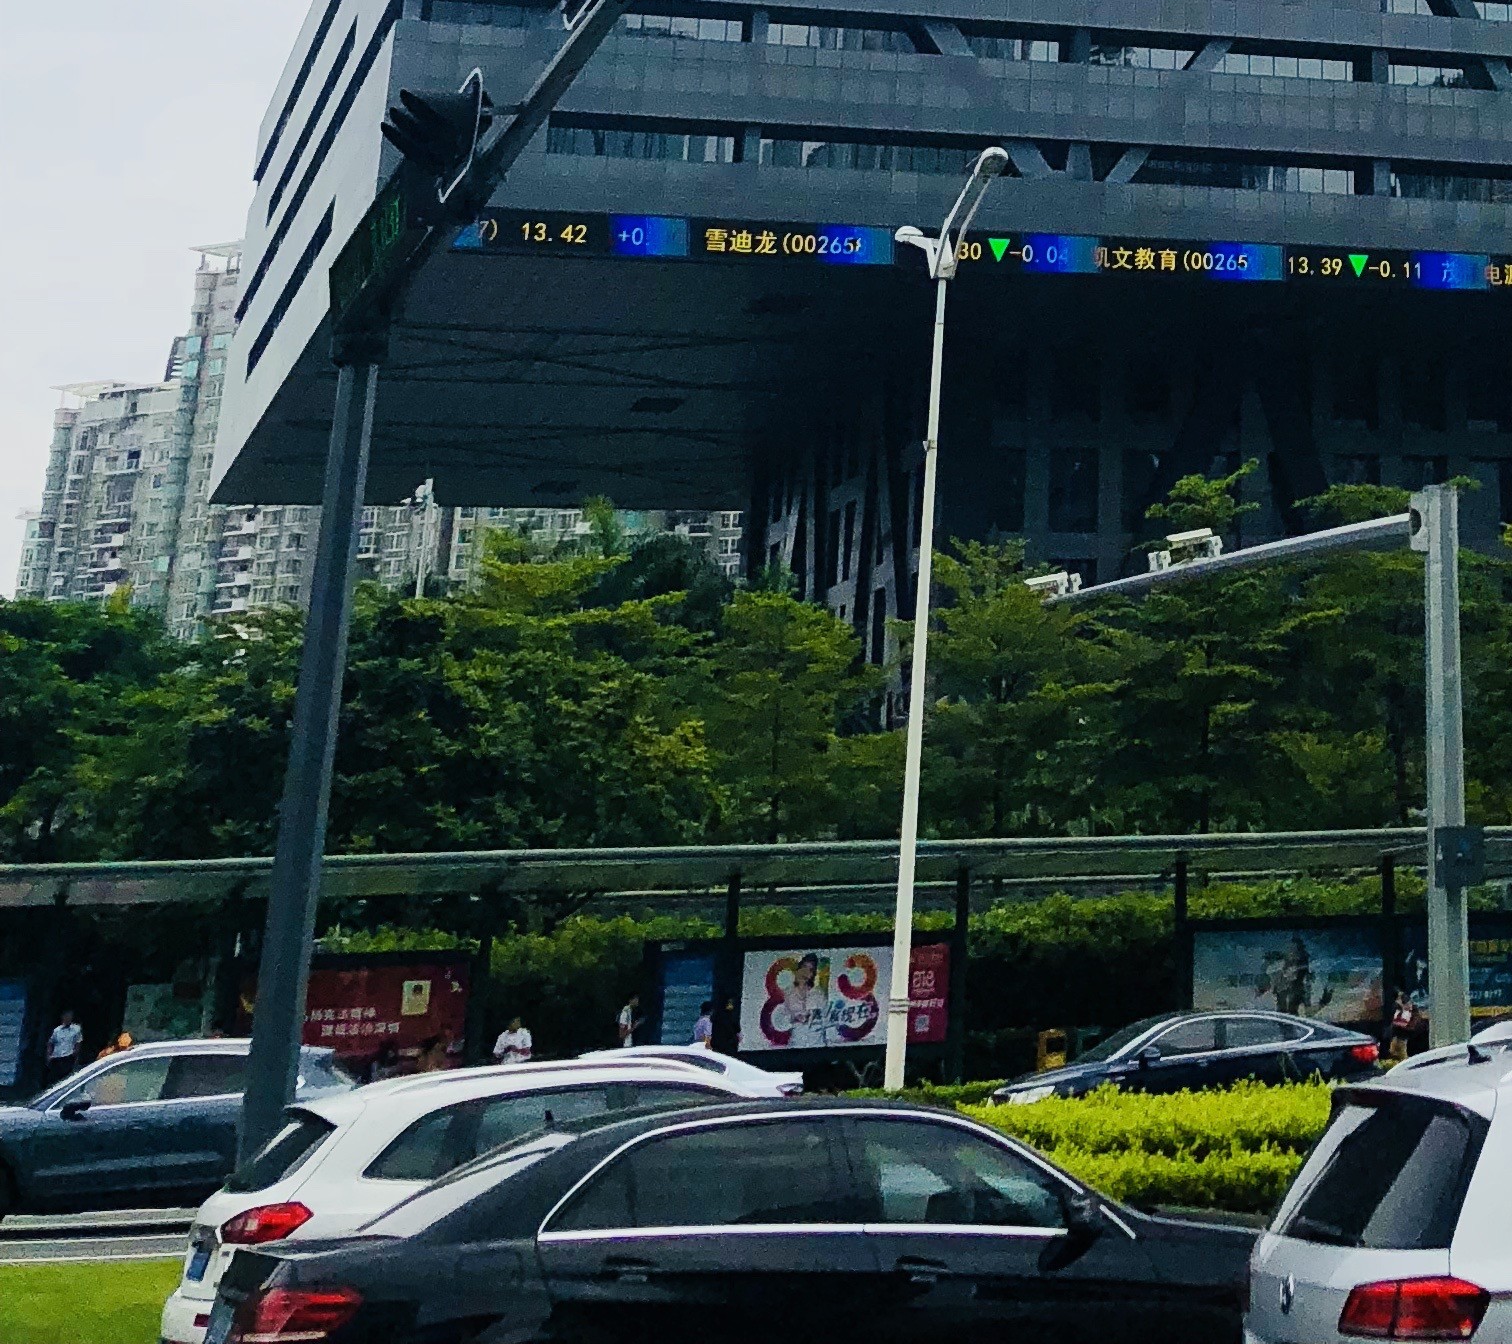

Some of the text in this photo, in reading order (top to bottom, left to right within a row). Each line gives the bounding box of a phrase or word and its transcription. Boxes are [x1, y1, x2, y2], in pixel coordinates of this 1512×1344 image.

[521, 222, 588, 244] 13.42
[1288, 256, 1343, 276] 13.39
[1368, 260, 1422, 279] -0.11
